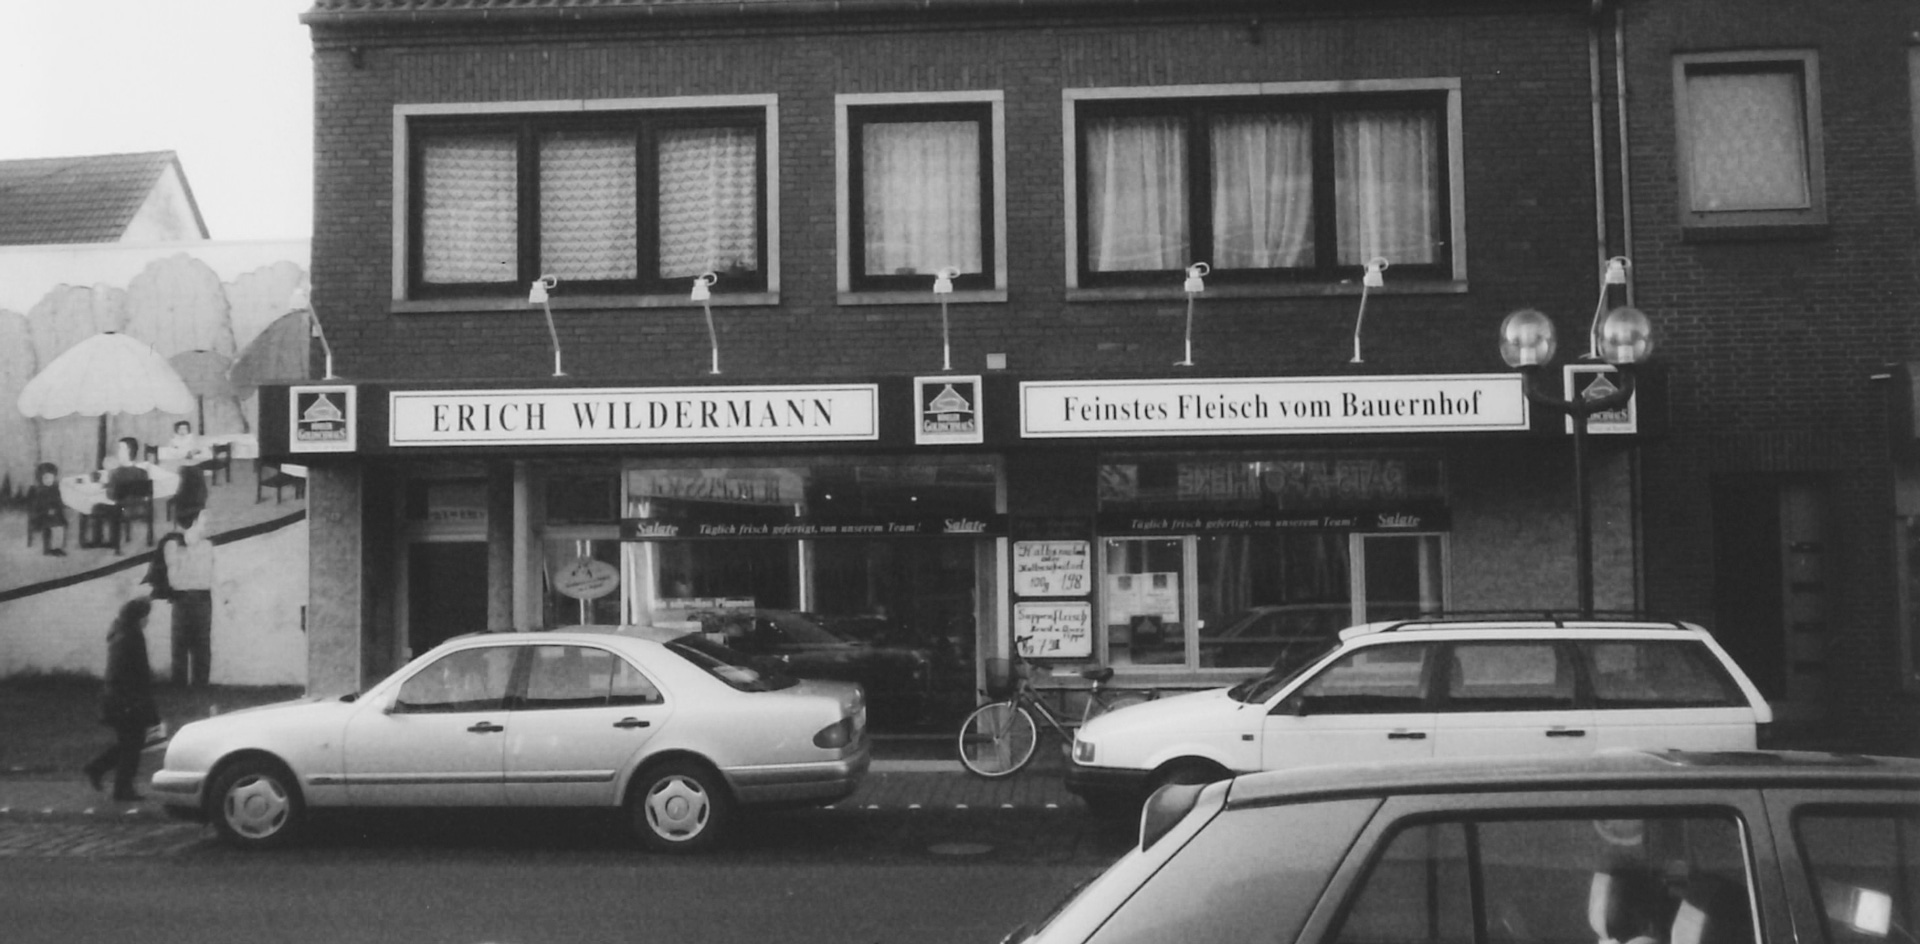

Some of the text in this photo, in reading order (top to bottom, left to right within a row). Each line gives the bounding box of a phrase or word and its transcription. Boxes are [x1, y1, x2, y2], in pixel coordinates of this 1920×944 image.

[1063, 390, 1483, 422] Feinstes Fleisch vom Bauernhof
[433, 399, 834, 433] ERICH WILDERMANN
[943, 518, 987, 533] Salate
[1171, 518, 1202, 530] frisch
[1275, 519, 1319, 527] unserem
[1377, 512, 1421, 528] Salate
[635, 521, 679, 537] Salate
[700, 523, 736, 536] Täglich
[739, 523, 769, 535] frisch
[820, 525, 837, 533] von
[841, 524, 884, 533] unserem
